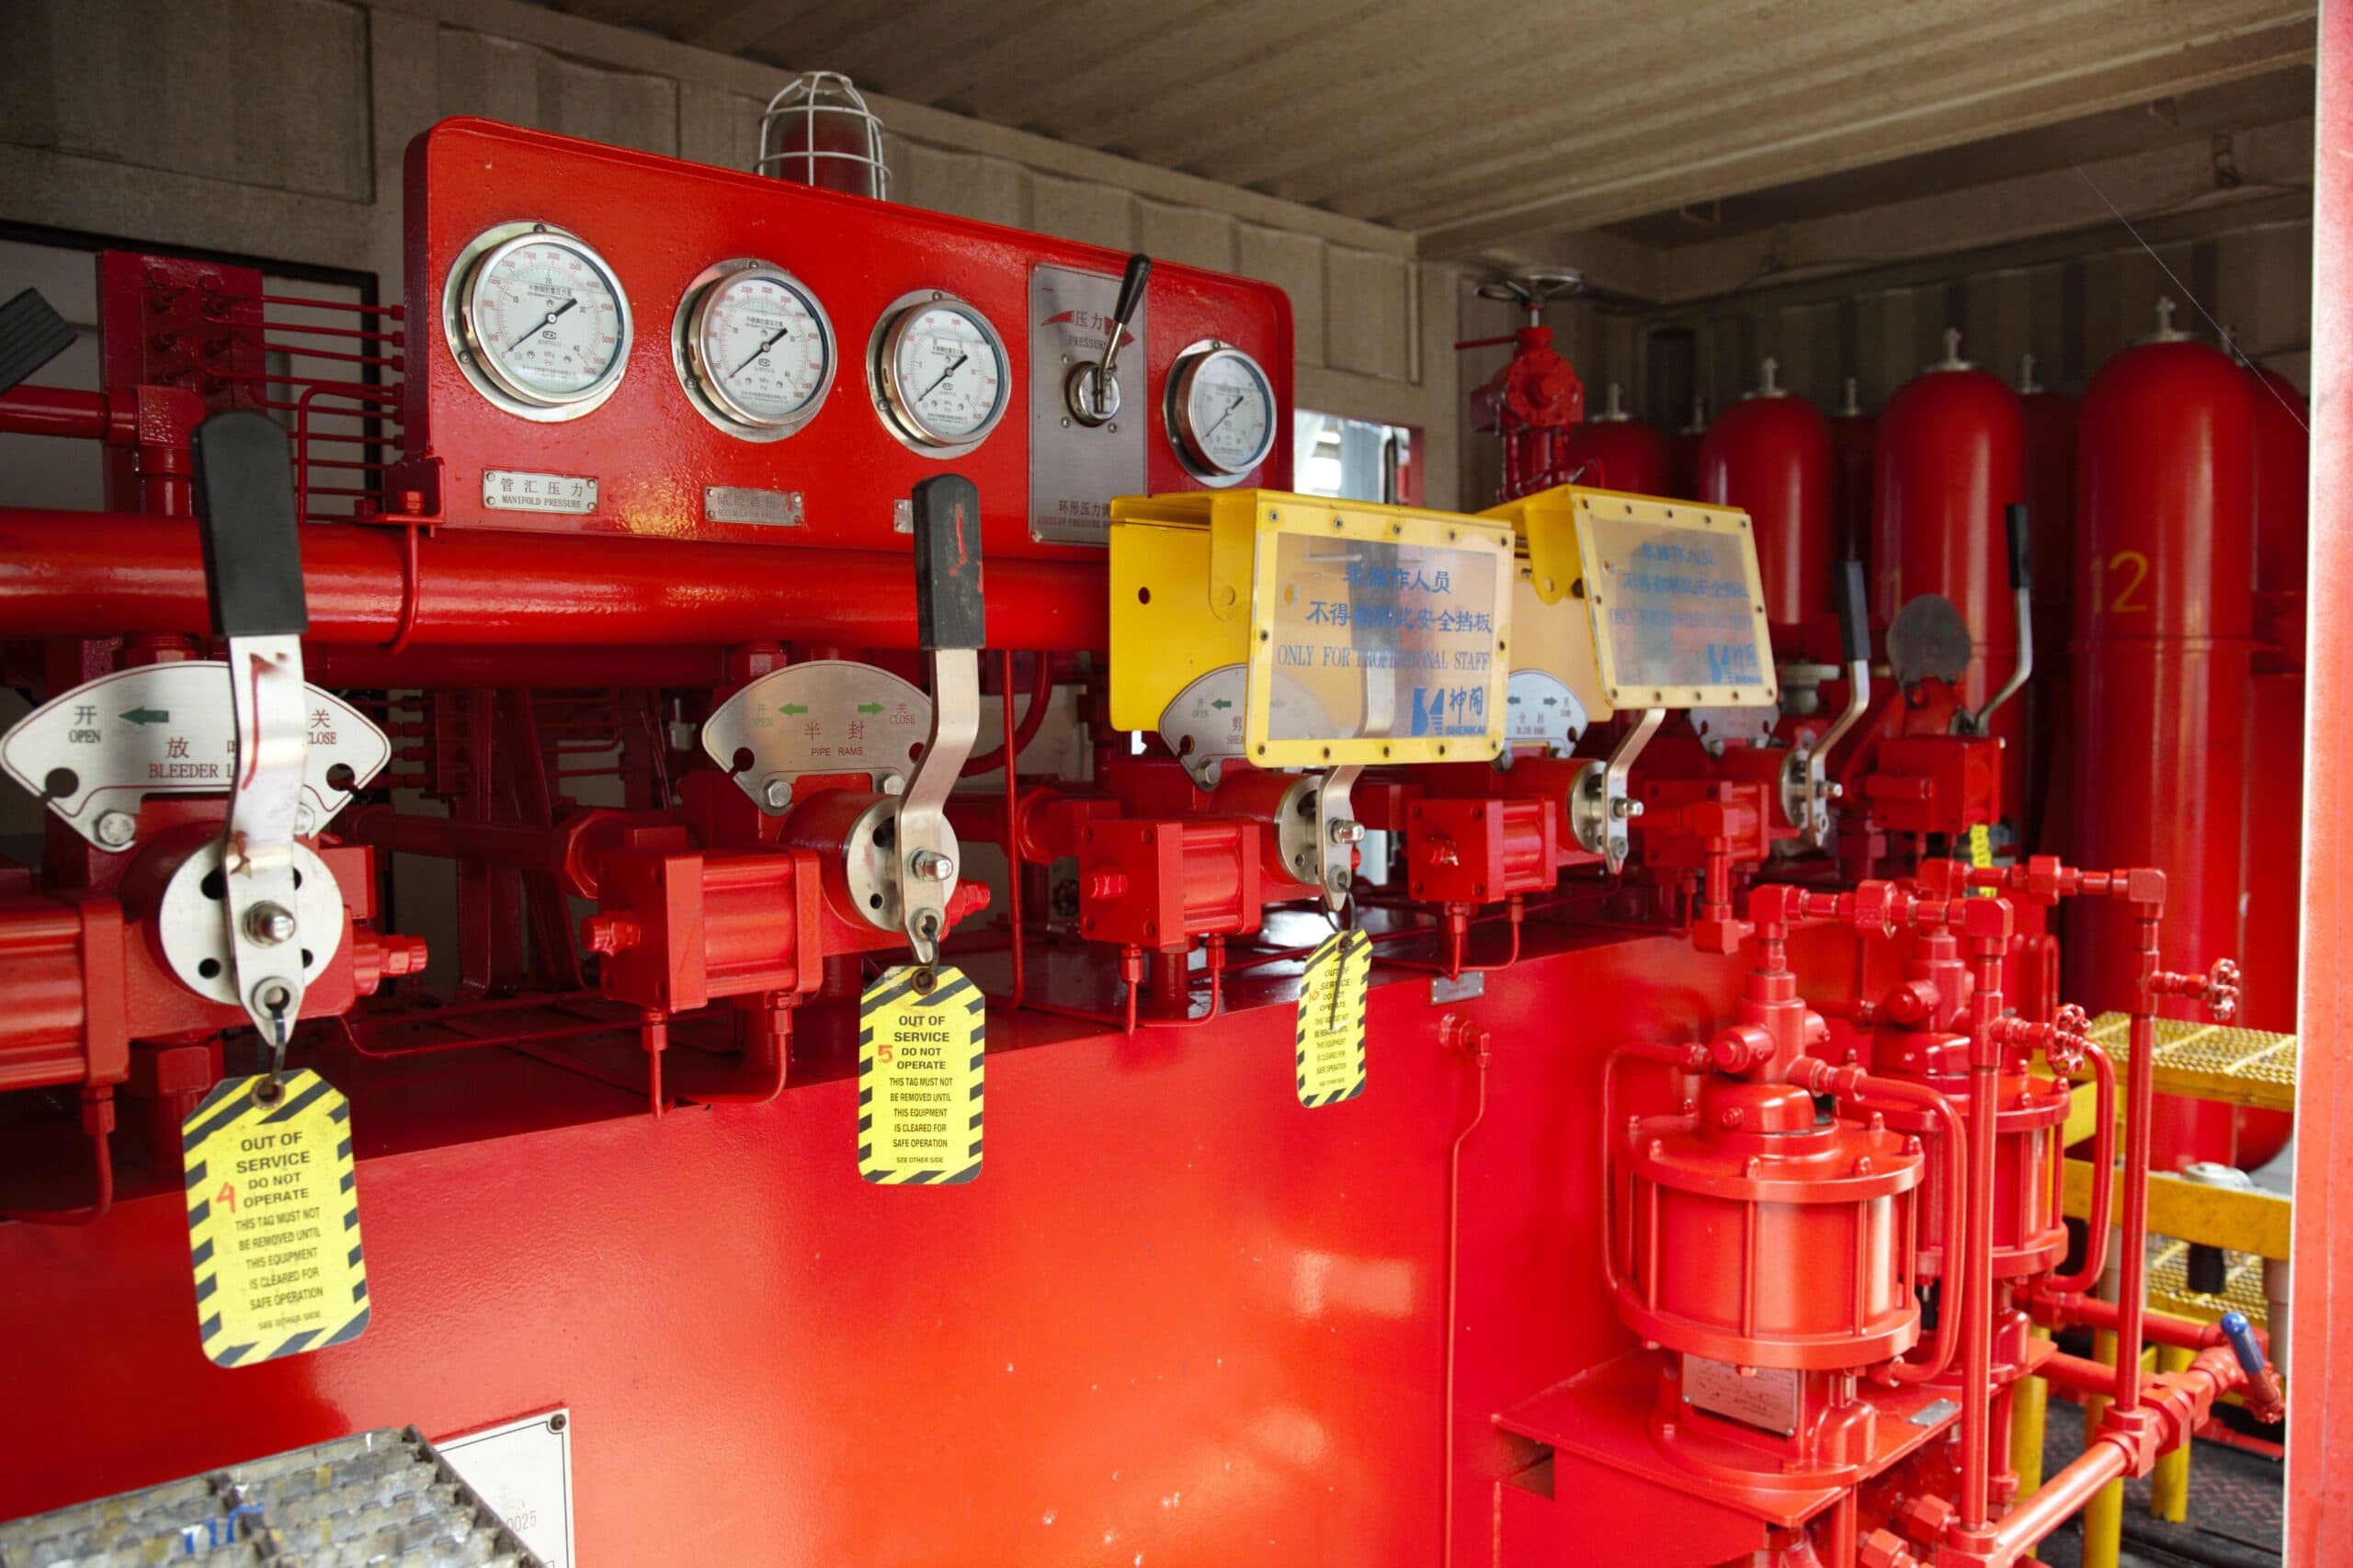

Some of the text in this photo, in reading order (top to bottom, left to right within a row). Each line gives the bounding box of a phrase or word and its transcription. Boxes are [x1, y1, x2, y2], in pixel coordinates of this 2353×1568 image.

[1068, 335, 1106, 350] PRESSUR
[500, 478, 583, 497] 管汇压力
[503, 494, 582, 508] MANIFOLD PRESSURE
[2089, 551, 2148, 614] 12
[1278, 645, 1314, 665] ONLY
[1324, 646, 1351, 667] FOR
[1455, 651, 1490, 671] STAFF
[74, 705, 97, 725] 开
[311, 709, 331, 728] 关
[889, 714, 915, 725] CLOSE
[68, 730, 101, 744] OPEN
[1445, 726, 1486, 735] SHENKAI
[307, 732, 337, 744] LOSE
[811, 746, 863, 756] PIPE RAMS
[149, 764, 219, 778] BLEEDER
[1320, 979, 1351, 991] SERCE
[899, 1016, 946, 1027] OUT OF
[893, 1032, 949, 1042] SERVICE
[878, 1044, 893, 1063] 5
[902, 1047, 941, 1056] DO NOT
[896, 1061, 946, 1070] OPERATE
[890, 1077, 953, 1086] THIS TAG MUST NOT
[890, 1093, 952, 1102] BE REMOVED UNTIL
[893, 1108, 948, 1118] THIS EQUIPMENT
[894, 1123, 947, 1132] IS CLEARED FOR
[241, 1131, 302, 1152] OUT OF
[892, 1139, 948, 1148] SAFE OPERATION
[236, 1151, 311, 1174] SERVICE
[248, 1172, 301, 1189] DO NOT
[243, 1187, 309, 1209] OPERATE
[235, 1207, 320, 1231] THIS TAG MUST NOT
[239, 1227, 322, 1251] BE REMOVED UNTIL
[246, 1246, 317, 1269] THIS EQUIPMENT
[249, 1267, 320, 1290] IS CLEARED FOR
[250, 1287, 324, 1311] SAFE OPERATION
